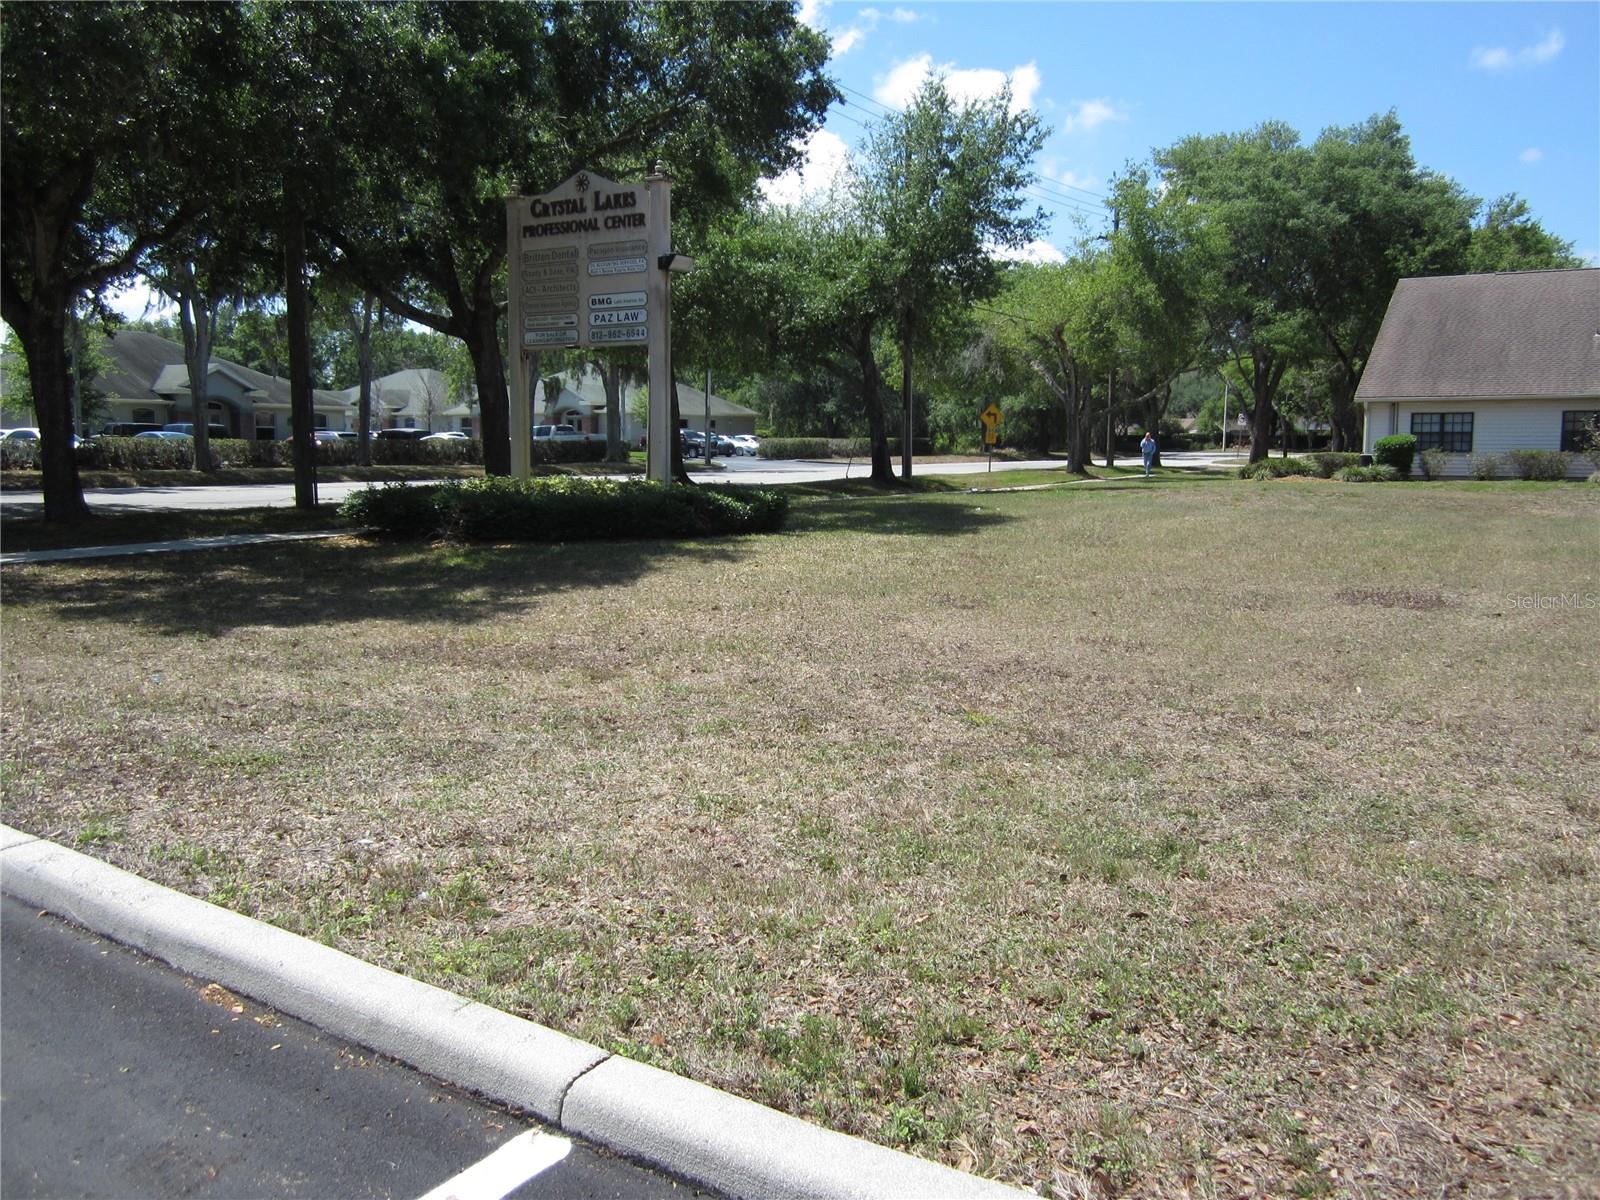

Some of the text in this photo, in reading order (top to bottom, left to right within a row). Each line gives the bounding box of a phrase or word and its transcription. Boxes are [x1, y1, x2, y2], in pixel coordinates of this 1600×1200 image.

[530, 191, 636, 217] CRYSTAL LAKES
[522, 213, 646, 238] PROFESSIONAL CENTER
[542, 283, 576, 293] Architects
[591, 297, 612, 306] BMG
[594, 312, 639, 323] PAZ LAW
